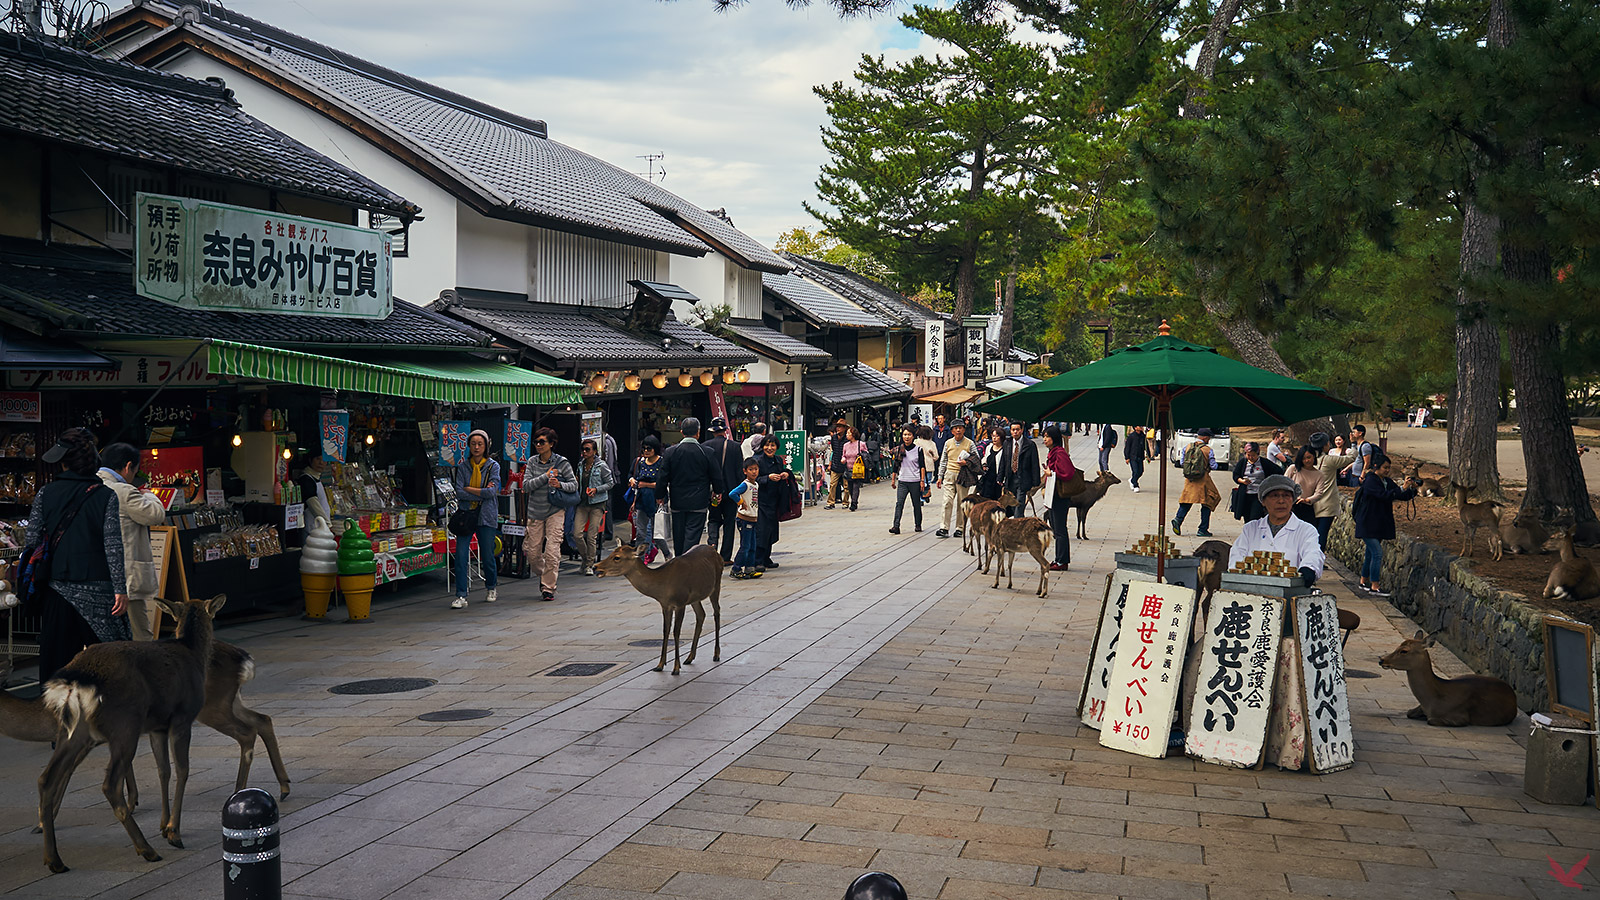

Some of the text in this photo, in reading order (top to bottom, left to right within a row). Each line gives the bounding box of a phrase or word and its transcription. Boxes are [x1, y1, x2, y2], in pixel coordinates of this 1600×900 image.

[147, 204, 165, 283] 預り所
[164, 206, 181, 284] 手荷物
[264, 220, 329, 243] 各社観光バス
[202, 230, 378, 298] 奈良みやげ百貨
[271, 292, 341, 309] 団体様サービス店
[928, 324, 941, 374] 御食事処
[137, 358, 148, 384] 各種
[328, 414, 339, 446] ソフト
[336, 423, 346, 464] クリーム
[446, 423, 459, 452] ソフト
[512, 422, 522, 449] ソフト
[519, 431, 530, 463] クリーム
[398, 552, 444, 573] FUJICOLOR
[1125, 593, 1164, 717] 鹿せんべい
[1160, 603, 1183, 684] 奈良鹿愛護会
[1243, 601, 1275, 709] 奈良鹿愛護会
[1203, 601, 1254, 732] 鹿せんべい
[1305, 602, 1337, 744] 鹿せんべい
[1112, 719, 1150, 740] ¥150
[1315, 741, 1349, 767] ¥150
